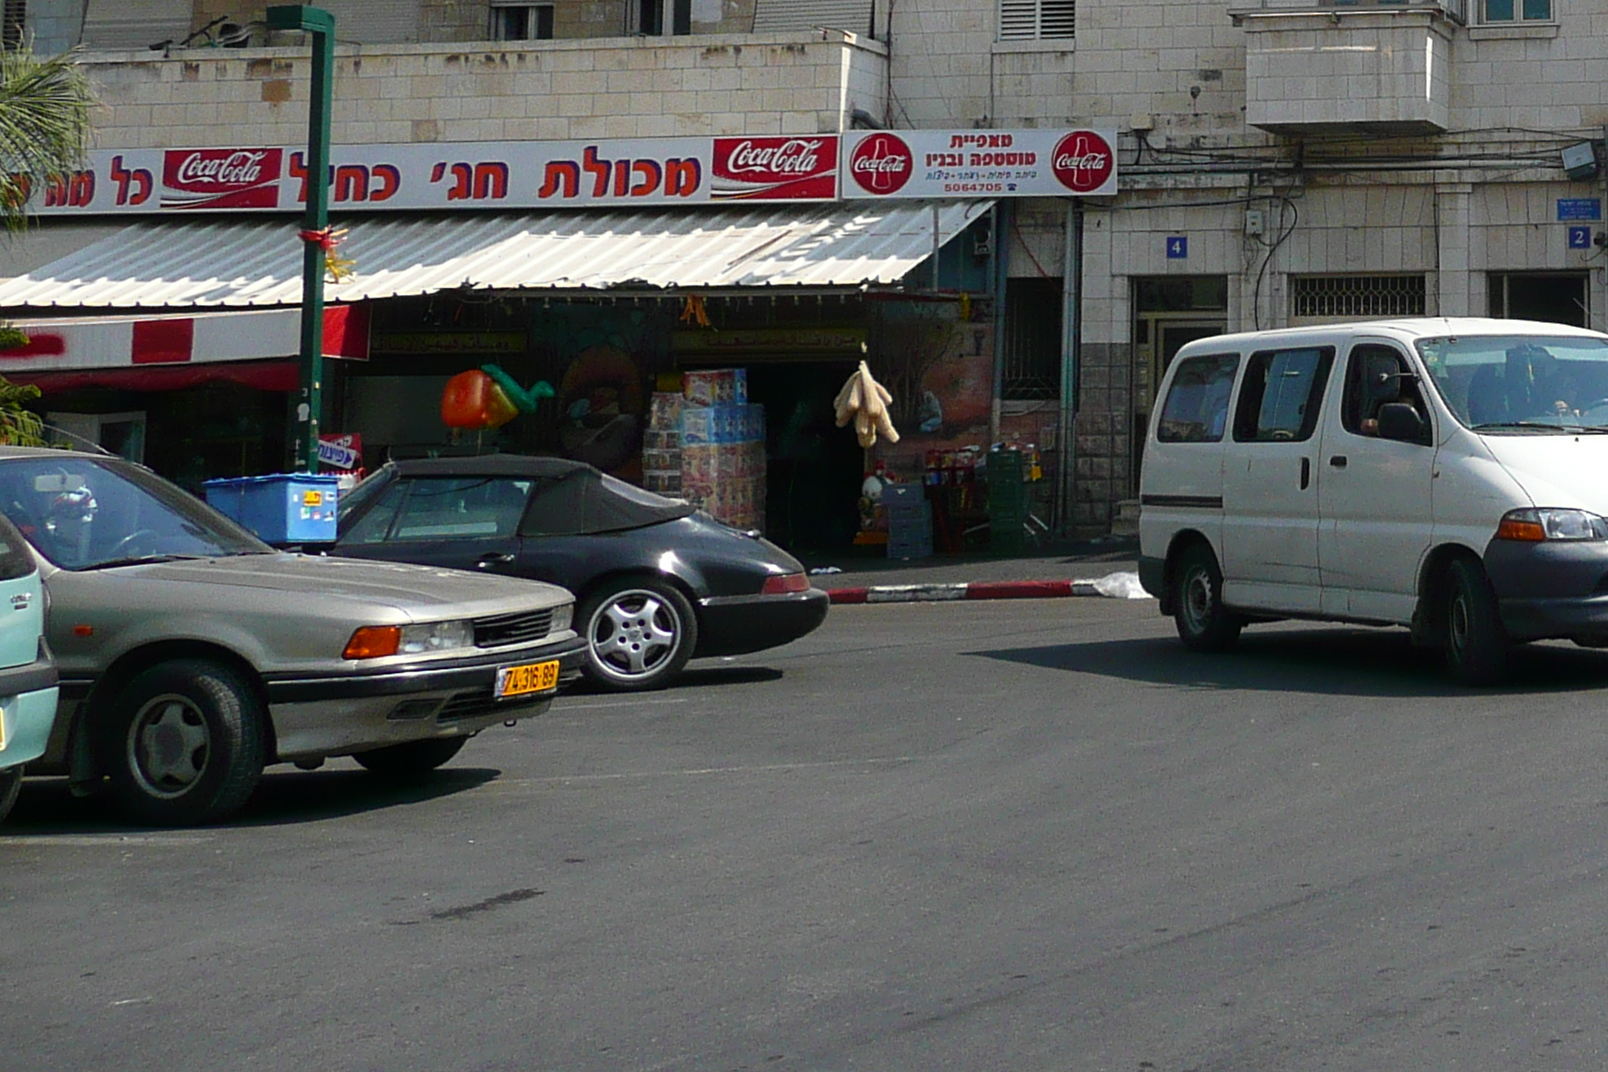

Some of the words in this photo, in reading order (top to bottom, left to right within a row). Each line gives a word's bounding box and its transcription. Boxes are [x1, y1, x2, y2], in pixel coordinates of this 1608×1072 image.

[949, 134, 1013, 148] מאפיית
[728, 140, 823, 173] Coca-Cola
[855, 155, 908, 172] Coca-Cola
[926, 152, 963, 167] ובניו
[1056, 153, 1107, 171] Coca-Cola
[178, 151, 267, 184] Coca-Cola
[538, 146, 701, 198] מכולת
[110, 155, 153, 205] כל
[944, 183, 1002, 192] 5064705
[1574, 231, 1584, 244] 2
[1172, 241, 1181, 254] 4
